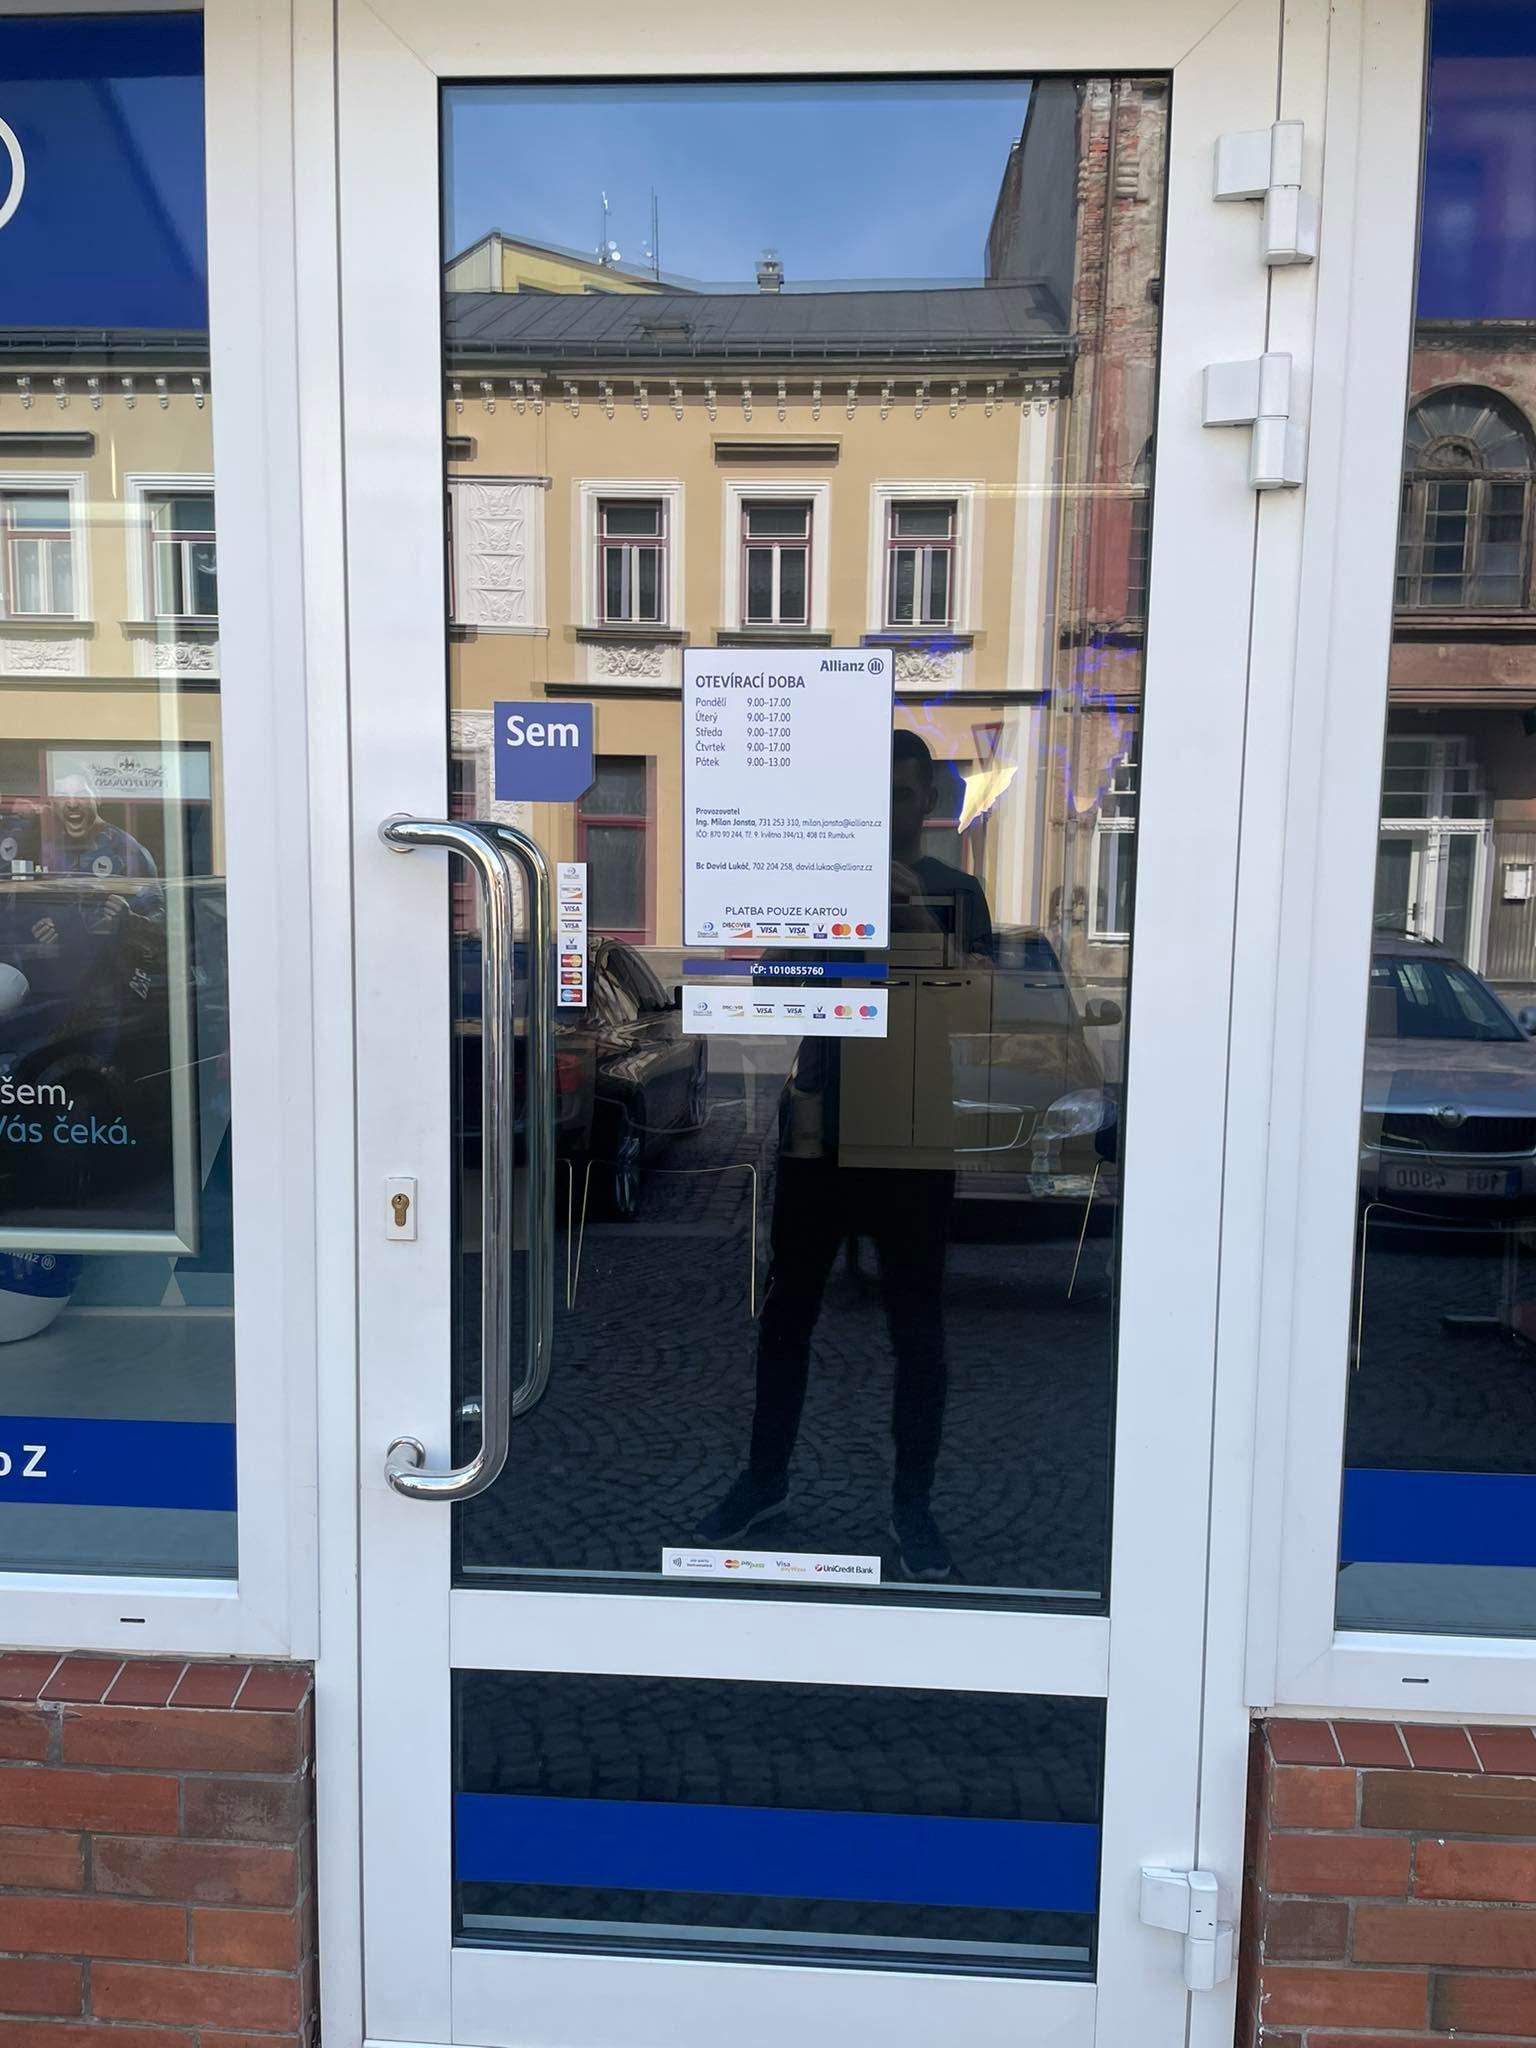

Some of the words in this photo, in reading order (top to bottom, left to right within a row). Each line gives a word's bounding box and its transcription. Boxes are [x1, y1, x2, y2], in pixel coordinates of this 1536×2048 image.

[819, 660, 865, 672] Allianz
[695, 672, 764, 688] OTEVÍRACÍ
[768, 675, 806, 688] DOBA
[695, 697, 727, 707] Pondělí
[695, 712, 718, 724] Úterý
[506, 715, 579, 747] Sem
[695, 727, 723, 737] Středa
[695, 740, 726, 752] Čtvrtek
[695, 756, 720, 767] Pátek
[695, 807, 740, 815] Provozovatel
[695, 818, 709, 827] Ing.
[710, 818, 731, 826] Milan
[828, 831, 856, 839] Rumburk
[706, 862, 727, 870] David
[725, 906, 764, 916] PLATBA
[767, 907, 802, 916] POUZE
[805, 907, 848, 917] KARTOU
[760, 926, 778, 934] VISA
[788, 927, 806, 935] VISA
[750, 963, 767, 974] IČP:
[769, 965, 824, 976] 1010855760
[53, 1114, 137, 1145] čeká.
[23, 1445, 47, 1477] Z
[776, 1560, 791, 1568] Visa
[823, 1565, 855, 1573] UniCredit
